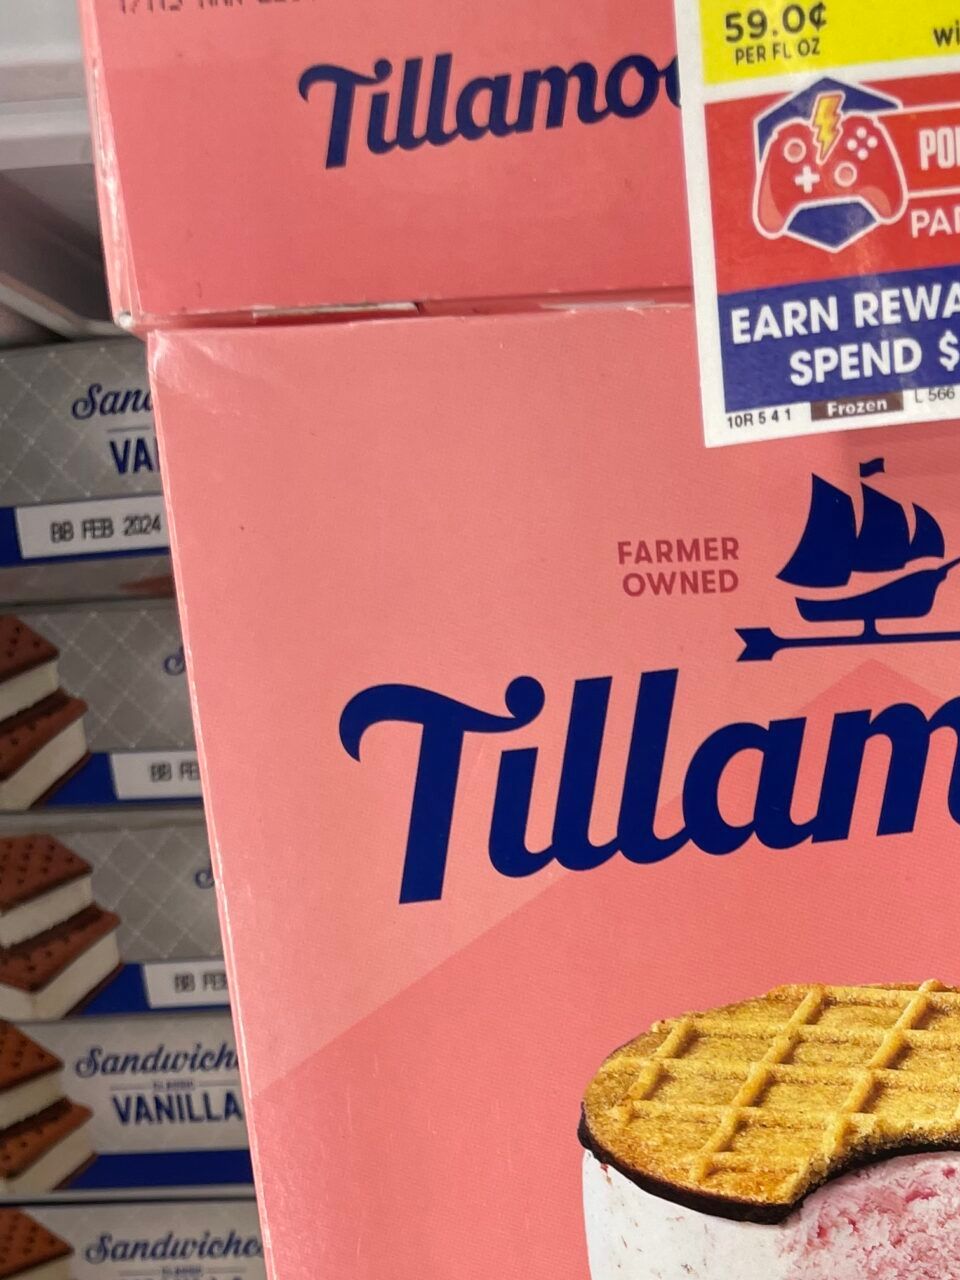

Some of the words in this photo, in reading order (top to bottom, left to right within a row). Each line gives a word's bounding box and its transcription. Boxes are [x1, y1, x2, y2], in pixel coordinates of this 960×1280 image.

[724, 2, 827, 43] 59.0¢
[736, 46, 767, 66] PER
[772, 43, 791, 60] FL
[797, 39, 821, 57] OZ
[730, 292, 839, 345] EARN
[788, 338, 923, 388] SPEND
[827, 398, 888, 418] Frozen
[928, 386, 956, 401] 566
[727, 414, 754, 429] 10R
[81, 516, 114, 539] FEB
[123, 513, 162, 537] 2024
[617, 536, 740, 565] FARMER
[622, 568, 739, 597] OWNED
[112, 1089, 245, 1126] VANILLA
